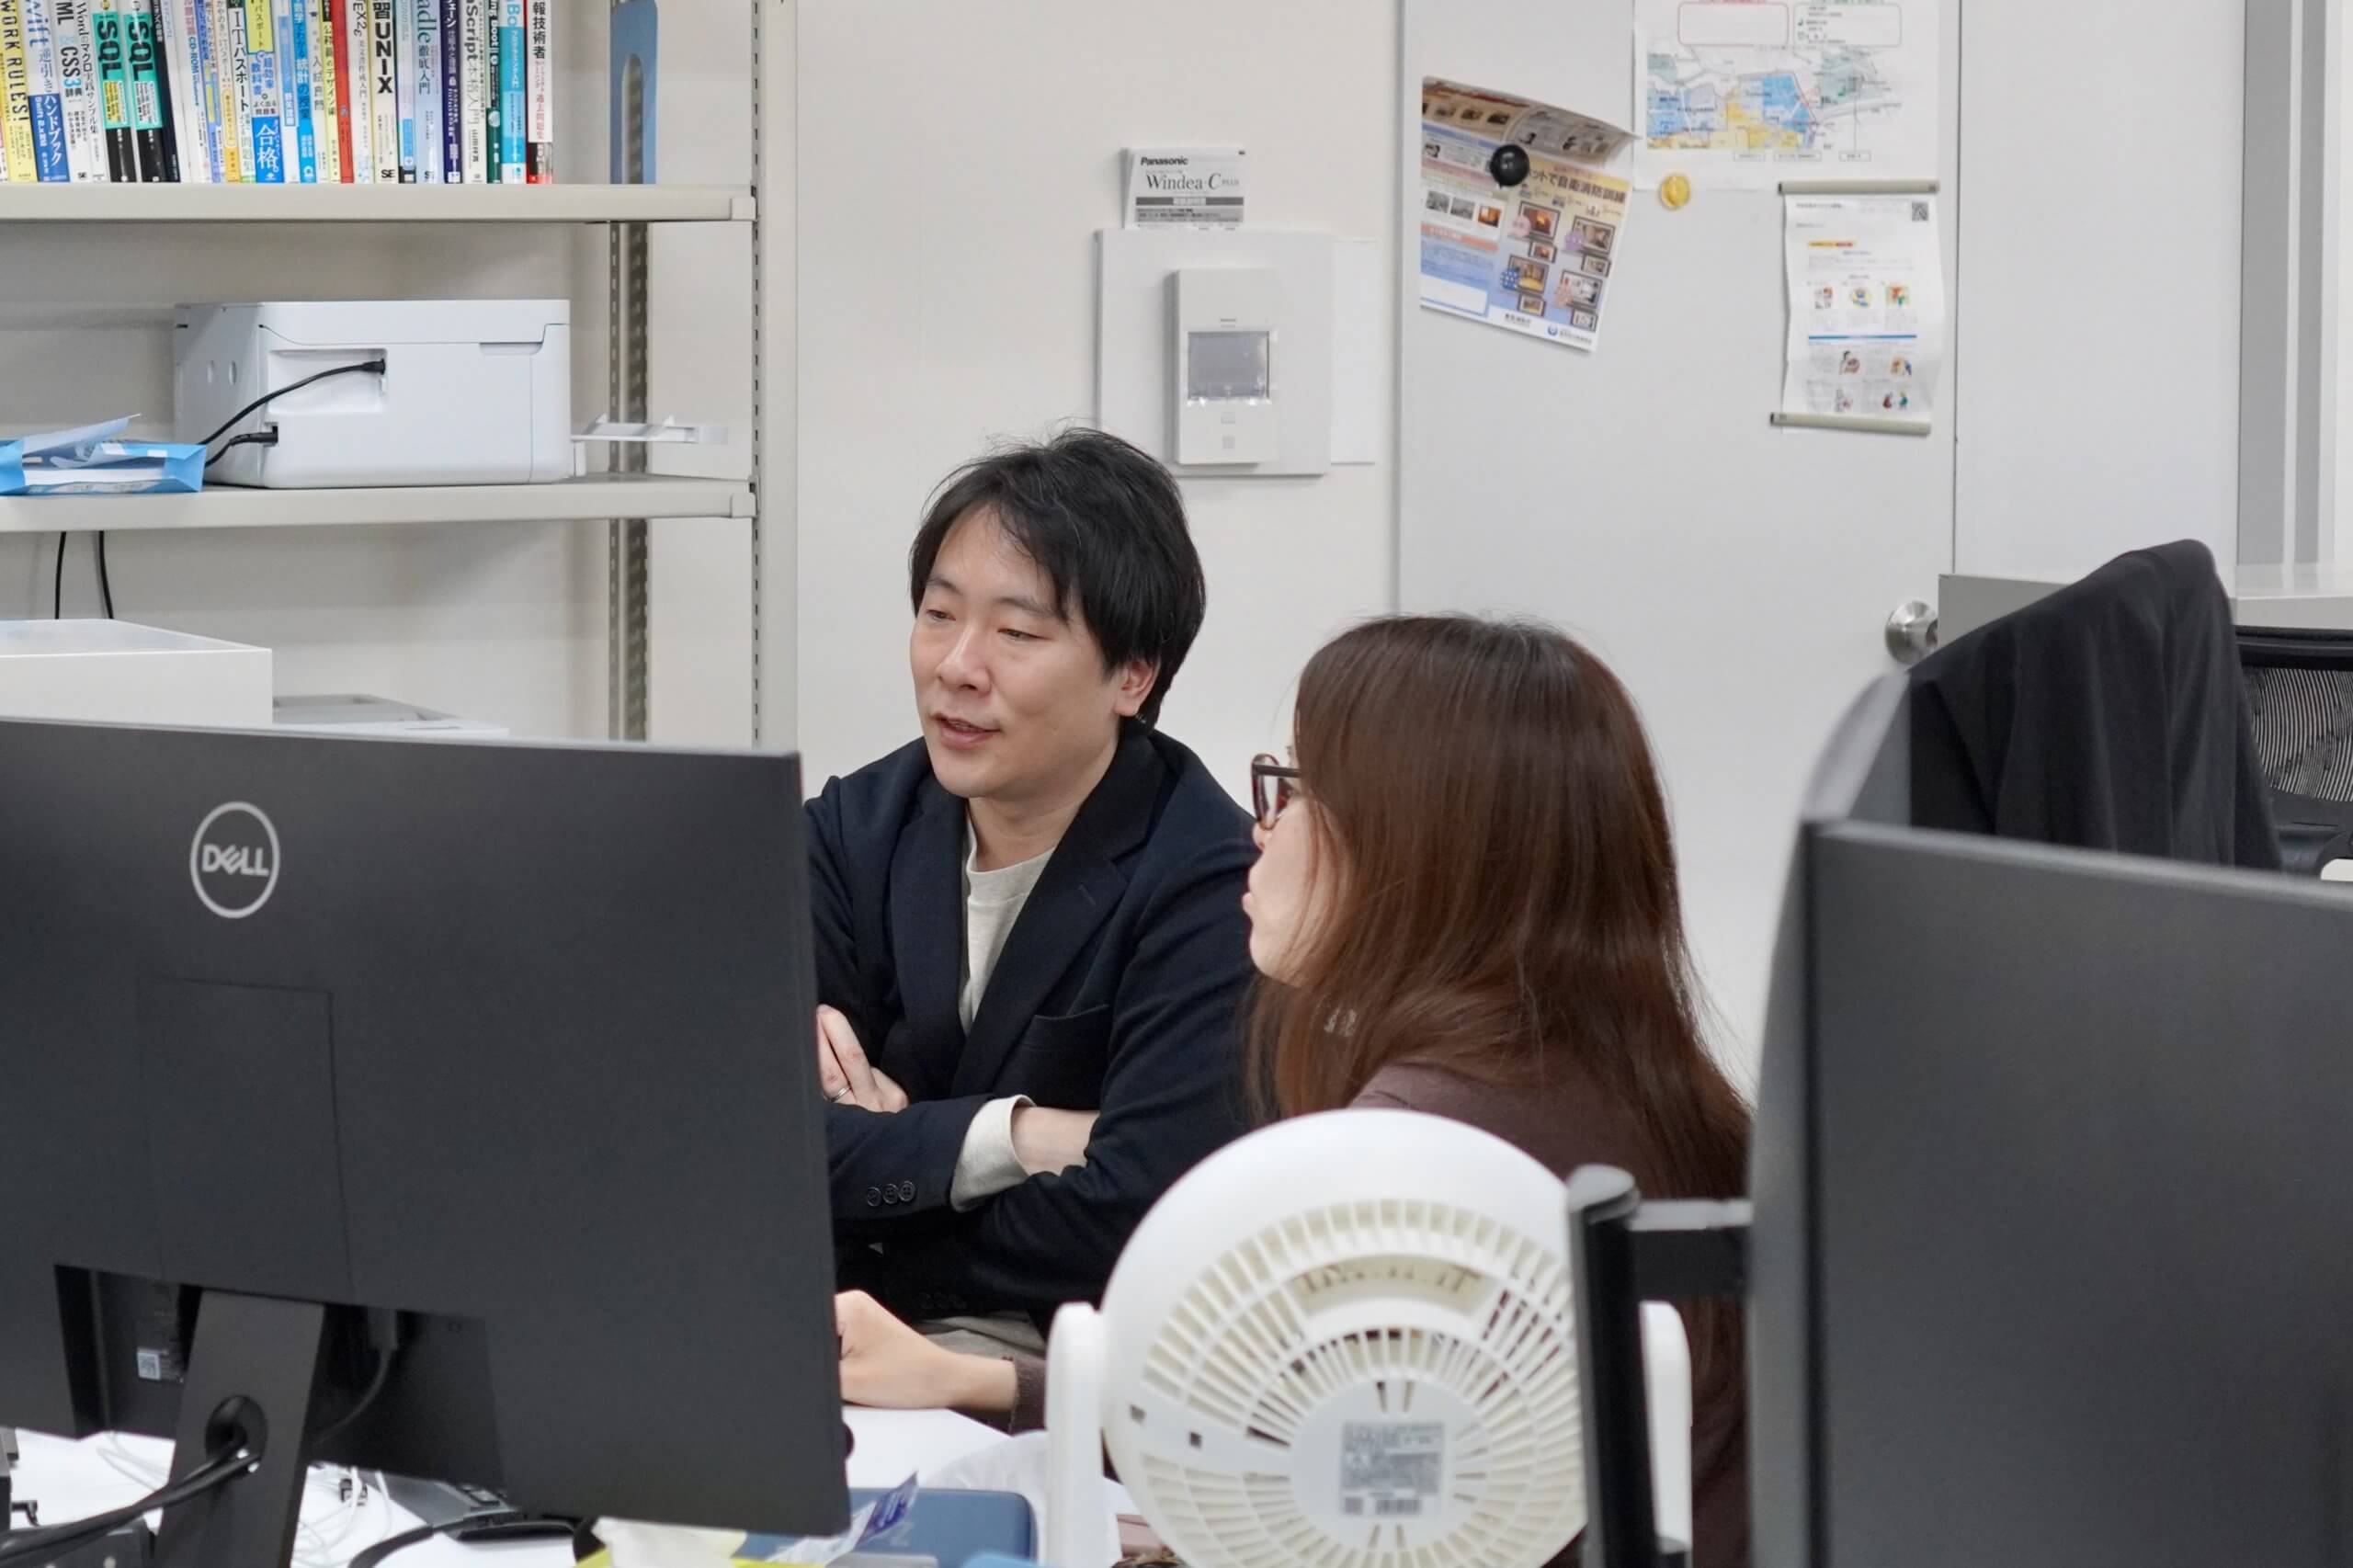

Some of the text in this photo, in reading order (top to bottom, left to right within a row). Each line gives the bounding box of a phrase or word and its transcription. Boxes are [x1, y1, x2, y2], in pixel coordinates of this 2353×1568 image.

[0, 0, 20, 51] WORK
[55, 0, 75, 26] ML
[97, 20, 122, 81] SQL
[129, 20, 153, 82] SQL
[188, 36, 199, 74] CD-ROM
[232, 10, 248, 112] ITパスポート
[7, 57, 29, 121] RULES!
[43, 95, 62, 167] ハンドブック
[1141, 156, 1188, 166] Panasonic
[1146, 174, 1203, 190] Windea
[1208, 173, 1222, 190] C
[201, 844, 270, 877] DELL
